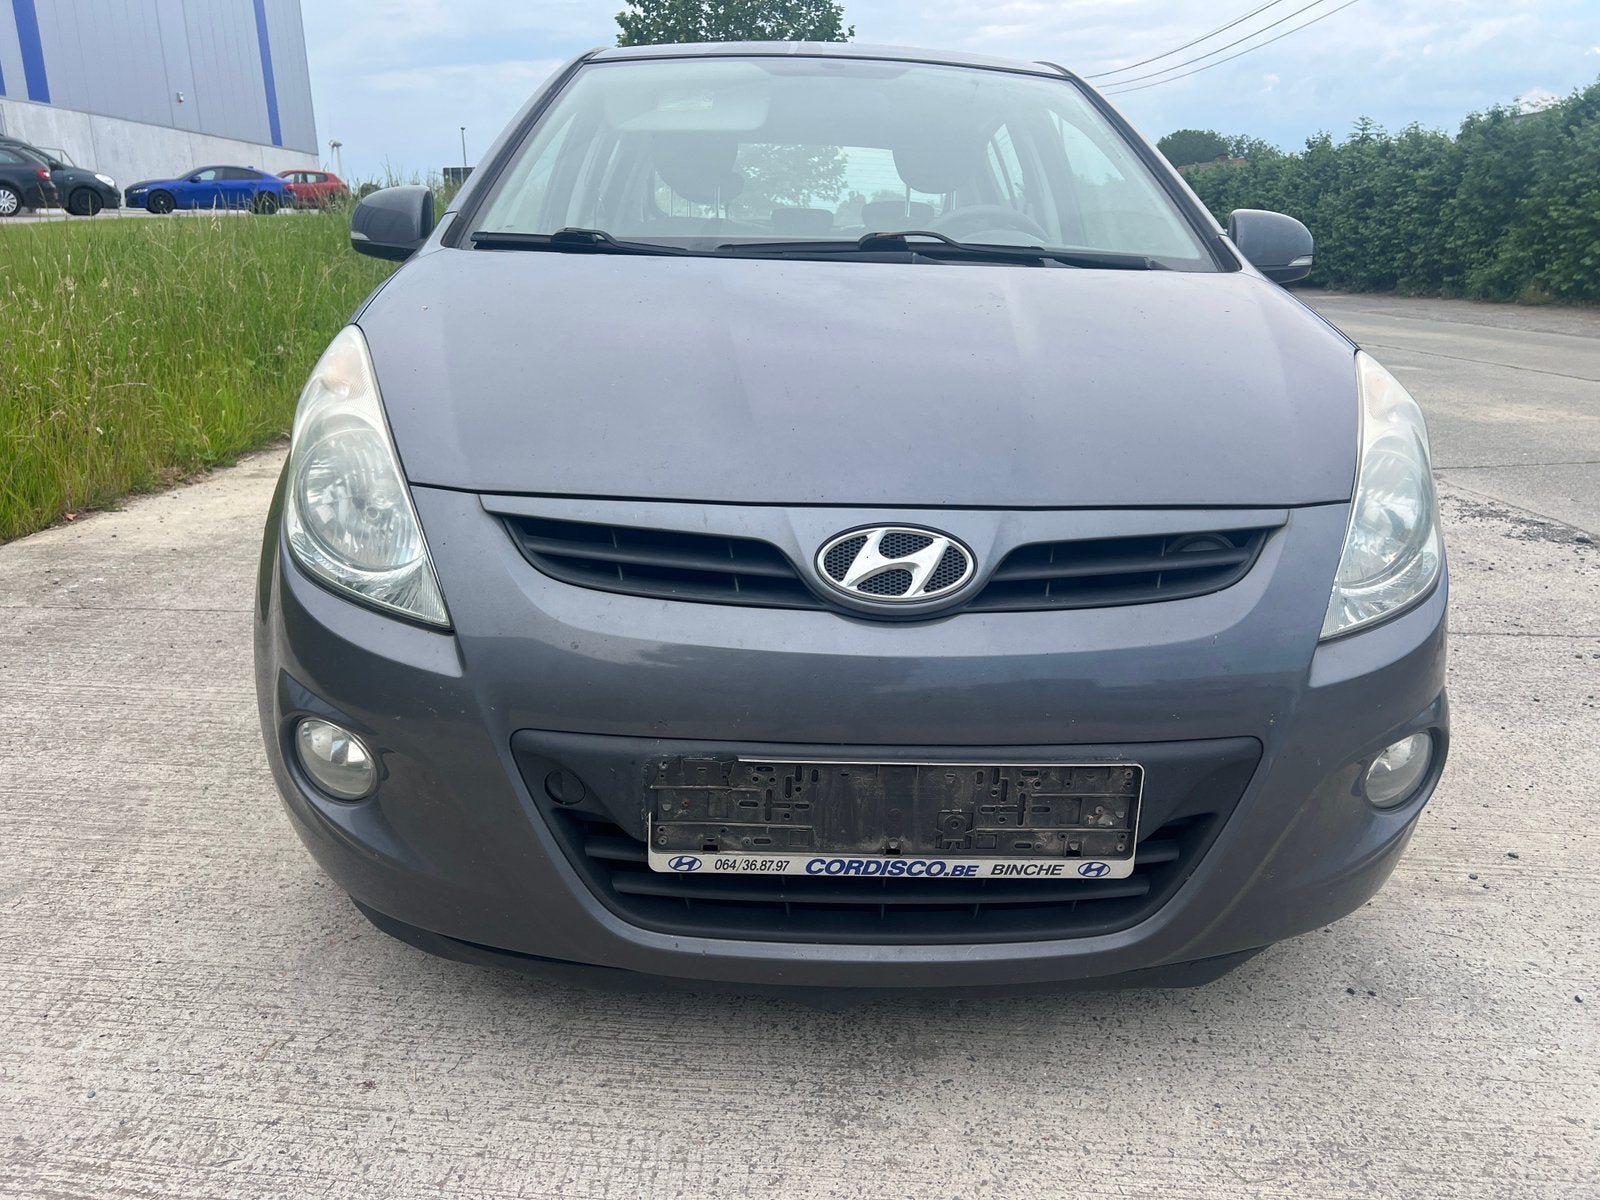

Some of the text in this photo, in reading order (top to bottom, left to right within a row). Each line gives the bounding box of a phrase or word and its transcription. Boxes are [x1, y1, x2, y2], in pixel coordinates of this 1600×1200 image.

[714, 858, 1065, 877] 064/36.87.97 CORDISCO.BE BINCHE
